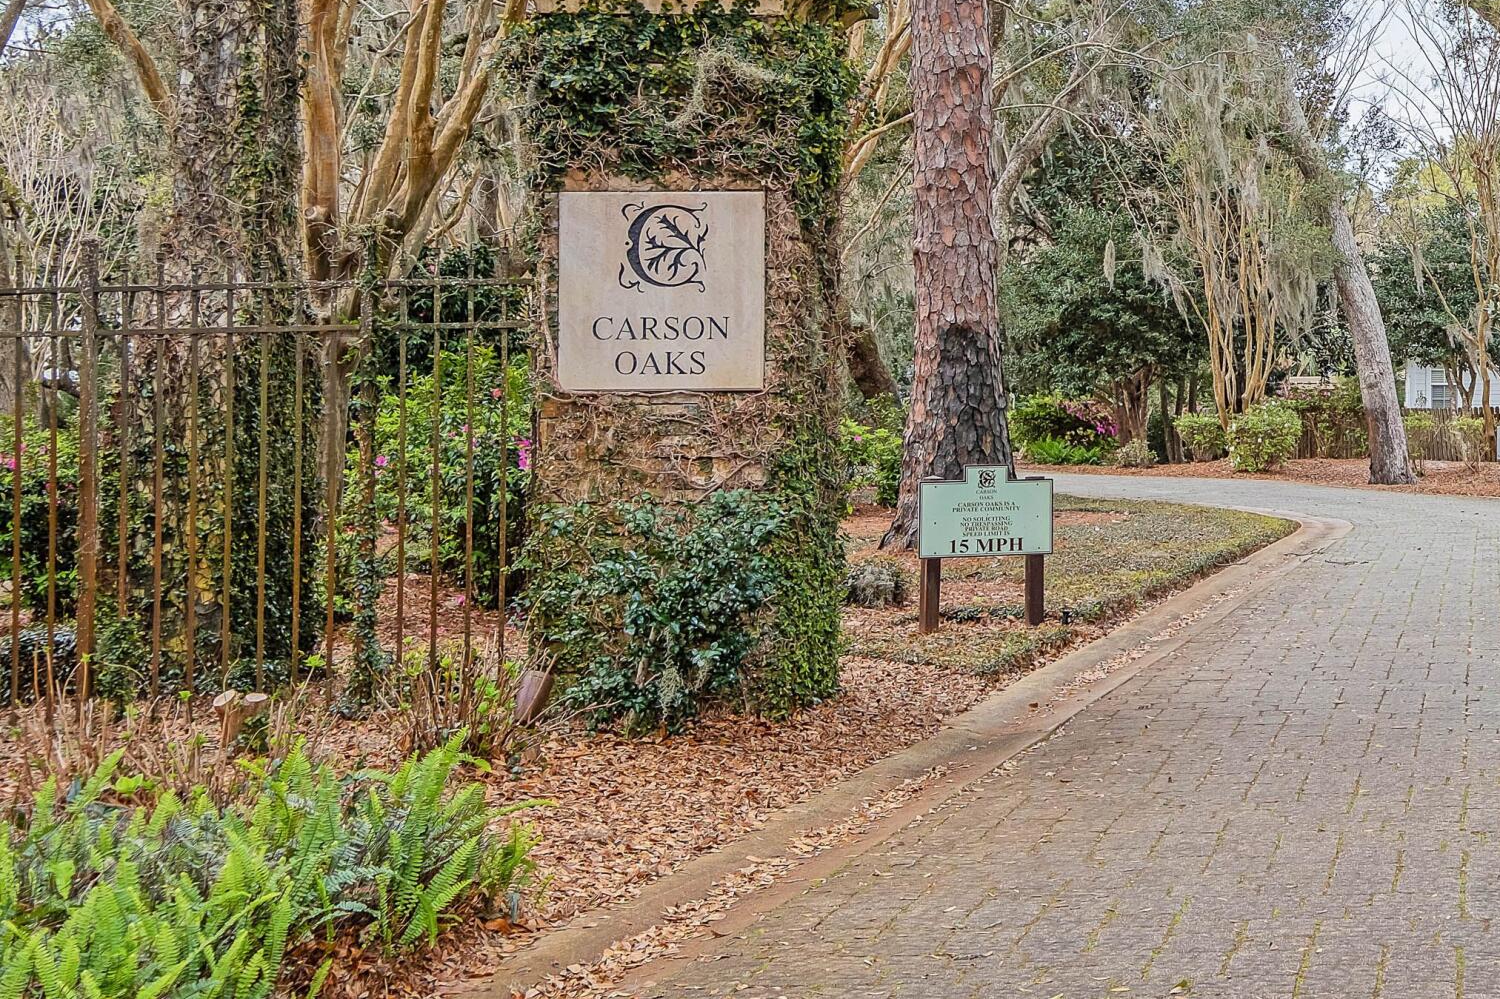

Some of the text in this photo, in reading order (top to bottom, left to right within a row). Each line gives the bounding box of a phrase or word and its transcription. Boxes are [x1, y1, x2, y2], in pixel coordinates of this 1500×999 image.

[592, 316, 730, 341] CARSON
[614, 350, 706, 375] OAKS
[949, 537, 1024, 554] 15 MPH
